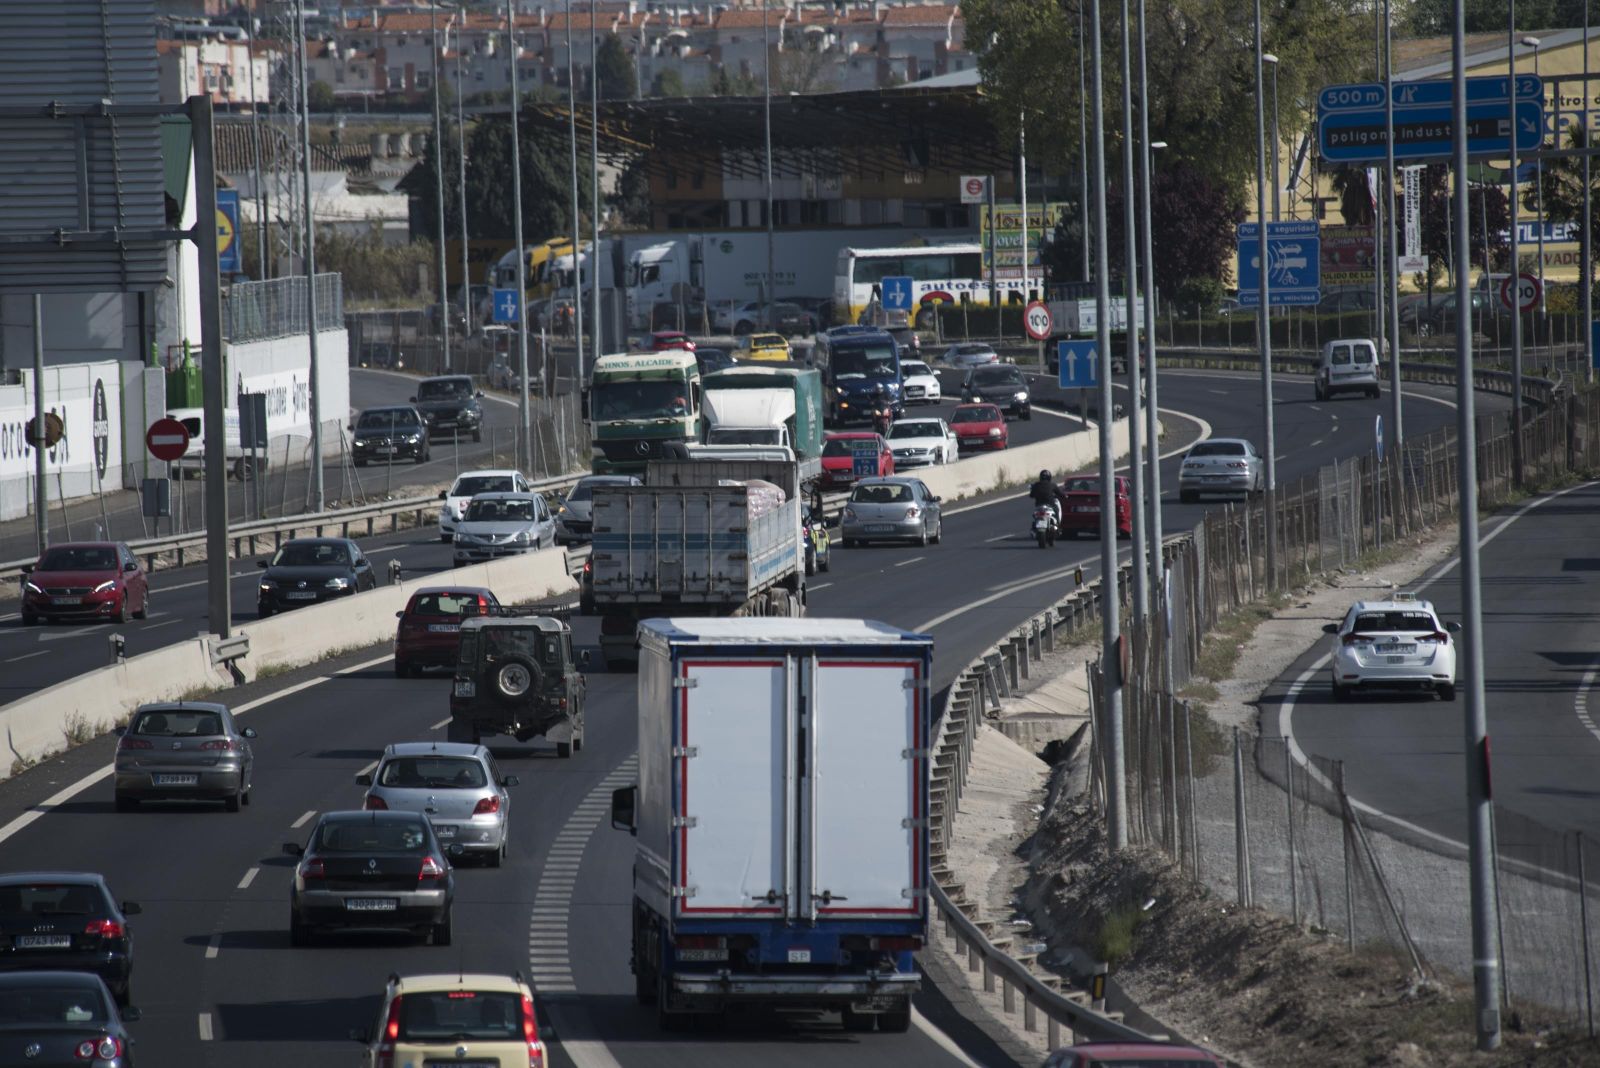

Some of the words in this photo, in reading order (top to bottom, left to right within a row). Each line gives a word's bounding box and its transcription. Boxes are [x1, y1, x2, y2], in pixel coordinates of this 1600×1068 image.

[1501, 80, 1534, 94] 122
[1327, 91, 1360, 105] 500
[1366, 92, 1380, 102] m
[1405, 170, 1413, 223] restaurante
[984, 212, 1055, 229] MOLNA
[1241, 226, 1256, 234] Por
[1274, 224, 1316, 234] seguridad
[1030, 314, 1049, 327] 100
[635, 358, 674, 368] ALCAIDE
[857, 465, 875, 475] 121
